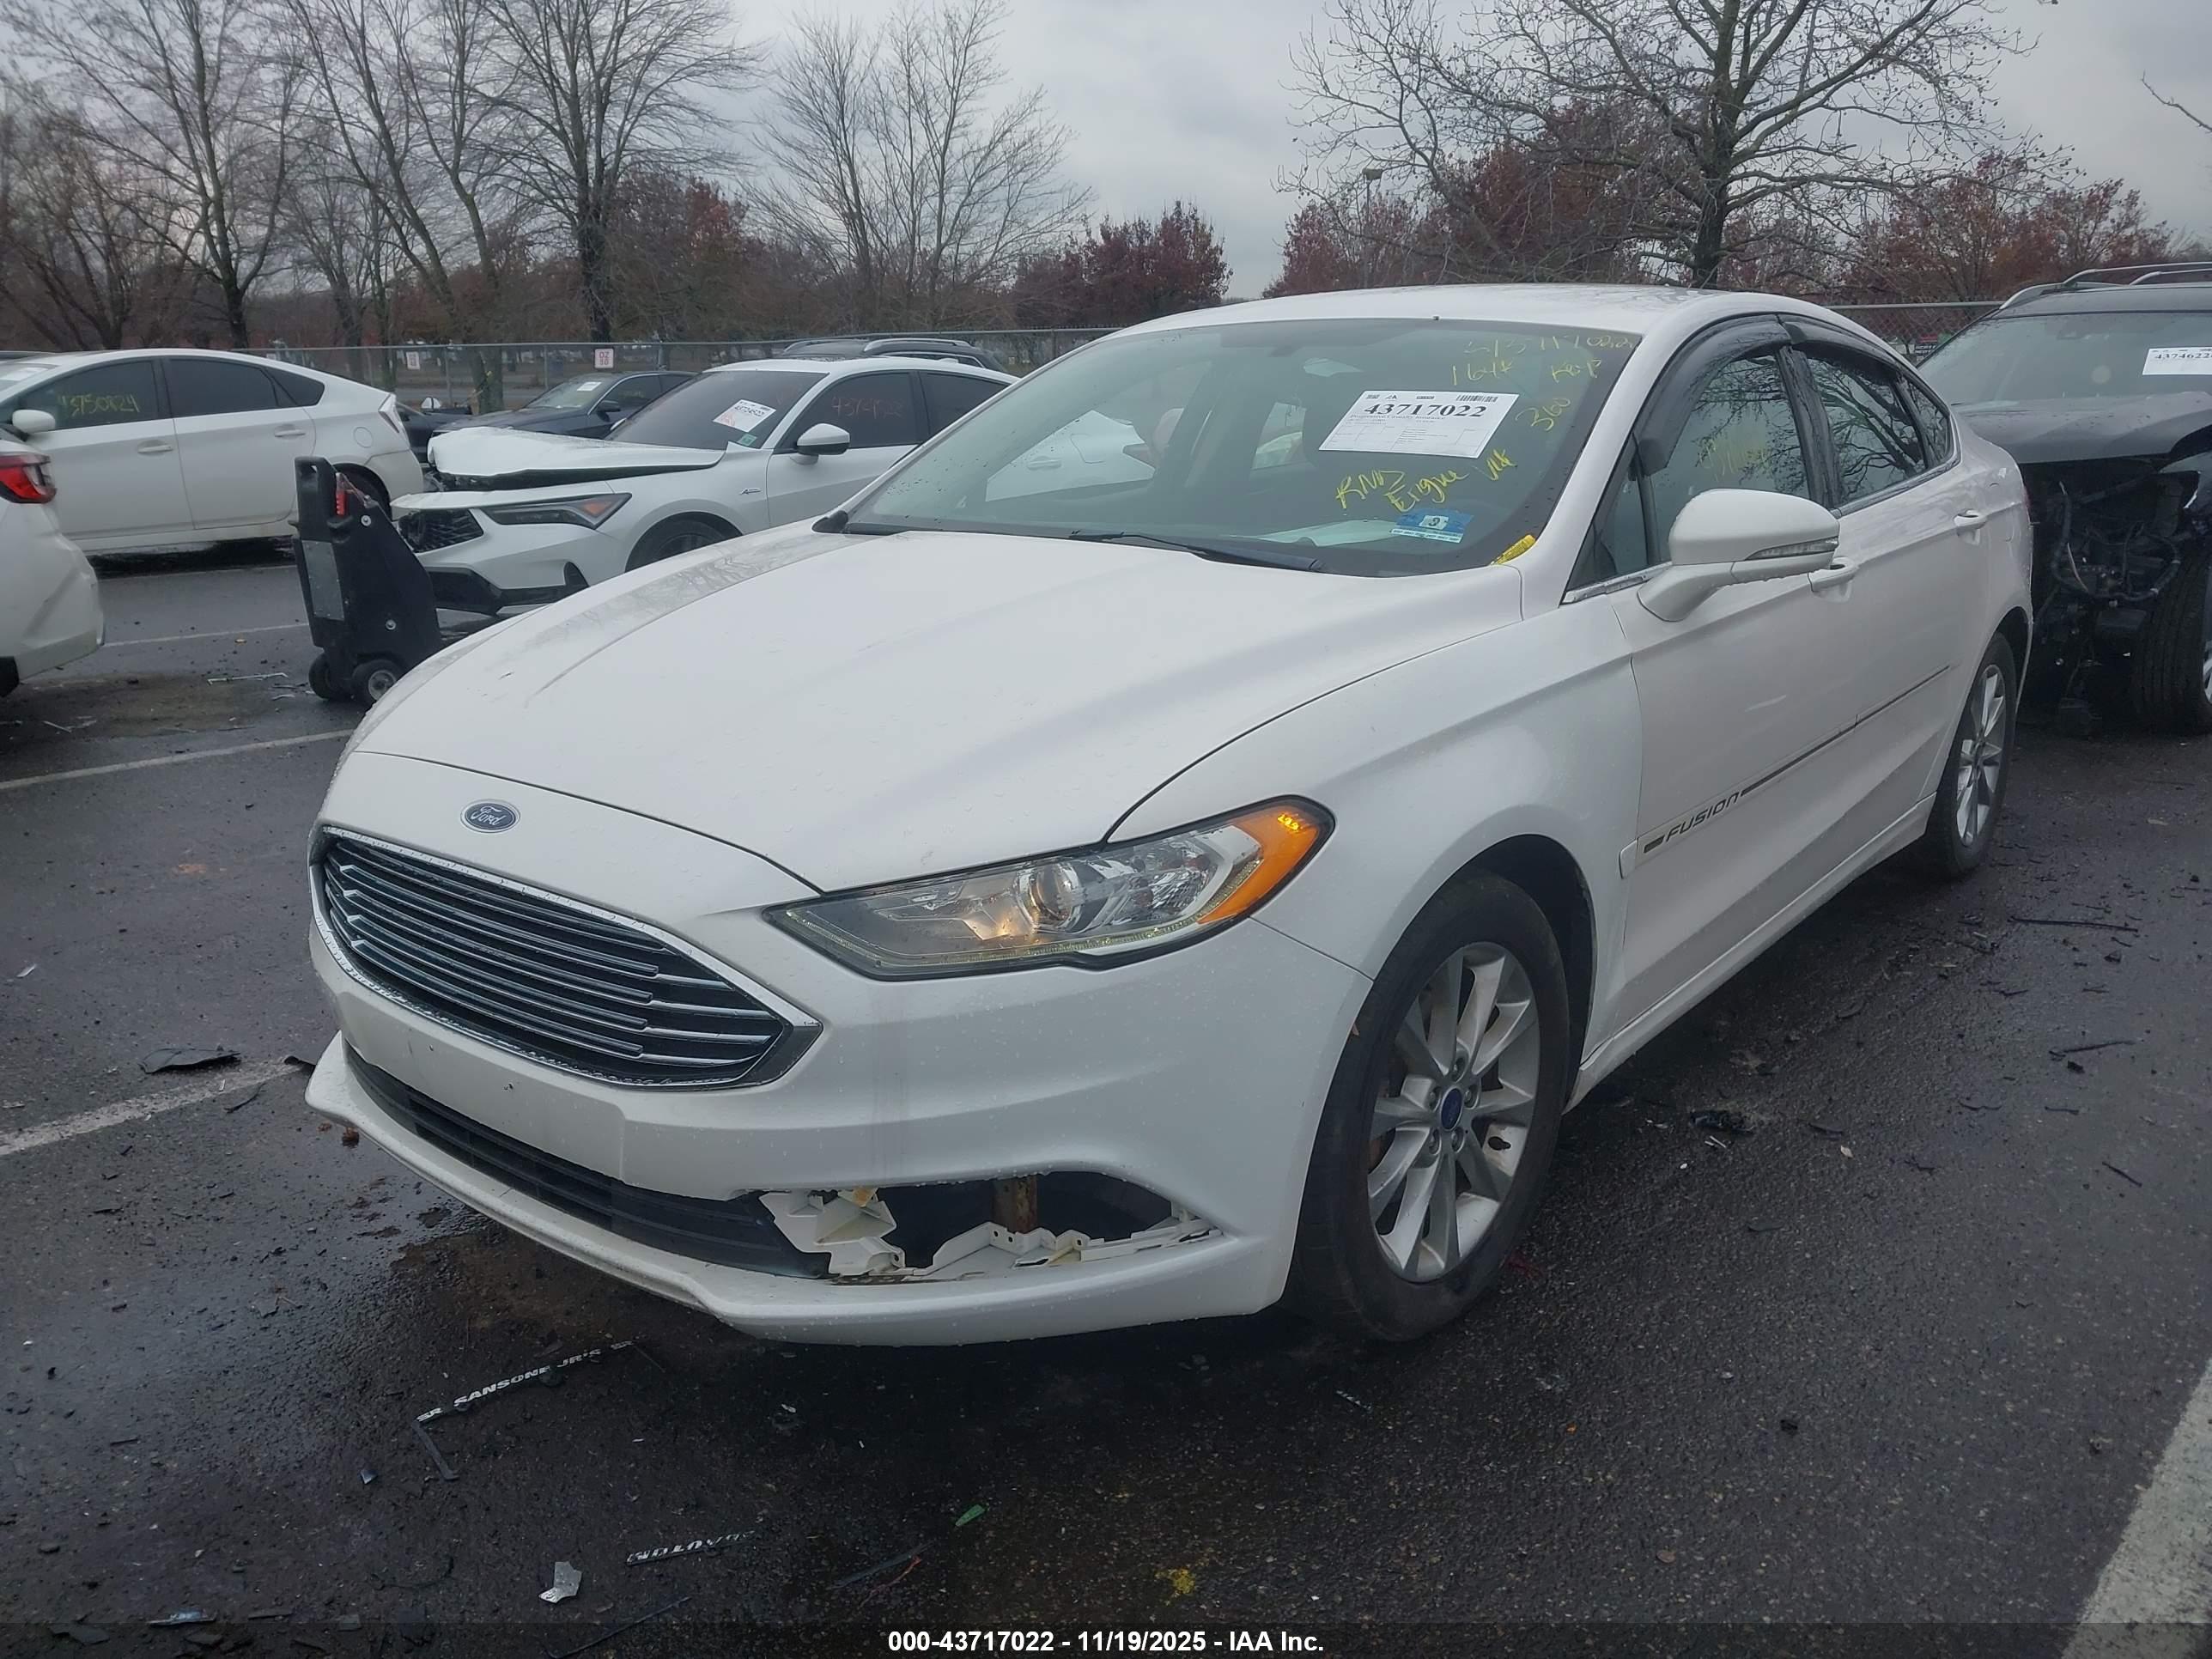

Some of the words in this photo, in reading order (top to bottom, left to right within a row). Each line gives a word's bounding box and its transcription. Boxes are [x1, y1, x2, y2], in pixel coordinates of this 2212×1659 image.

[1364, 403, 1487, 417] 43717022
[470, 805, 507, 825] Ford
[453, 1365, 550, 1407] SANSONE
